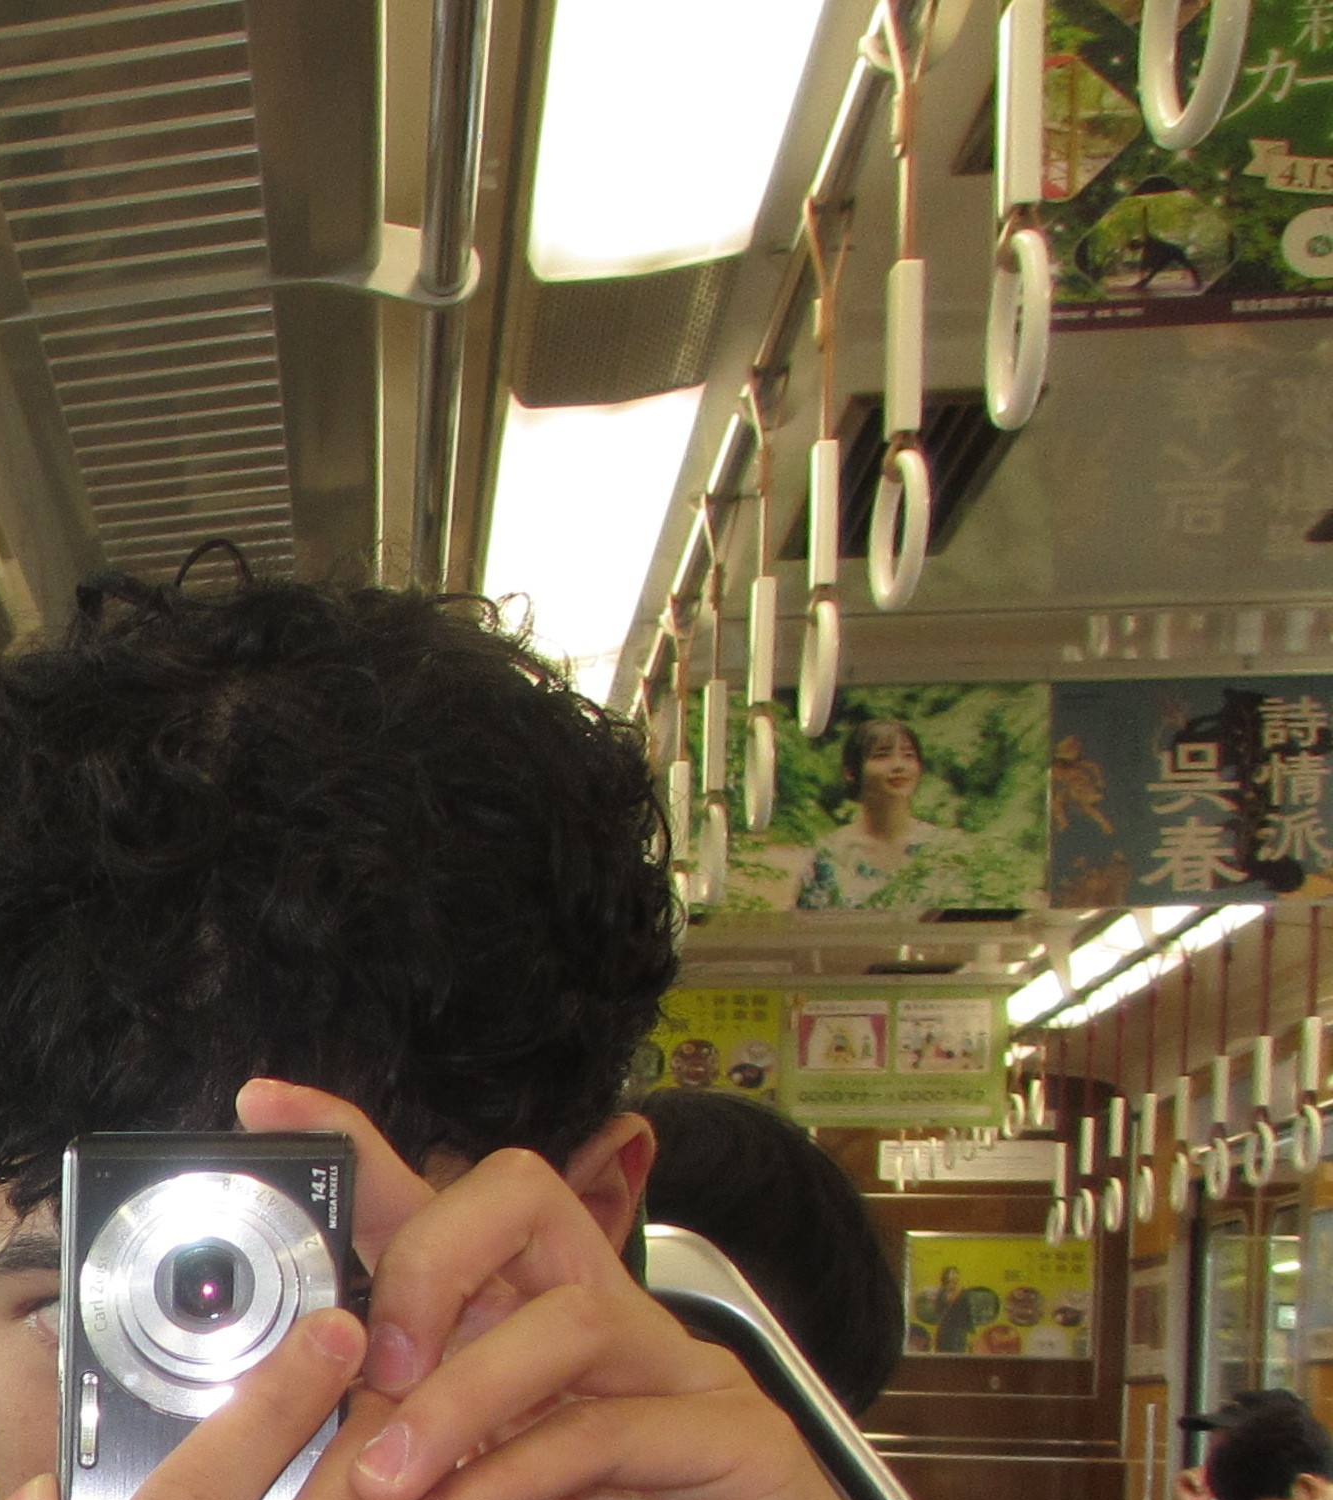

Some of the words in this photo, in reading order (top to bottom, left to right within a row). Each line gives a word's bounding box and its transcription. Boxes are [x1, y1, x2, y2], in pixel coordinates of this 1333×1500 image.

[311, 1167, 327, 1201] 14.1
[328, 1165, 338, 1198] PIXELS
[328, 1199, 338, 1229] MEGA
[90, 1300, 107, 1332] Carl
